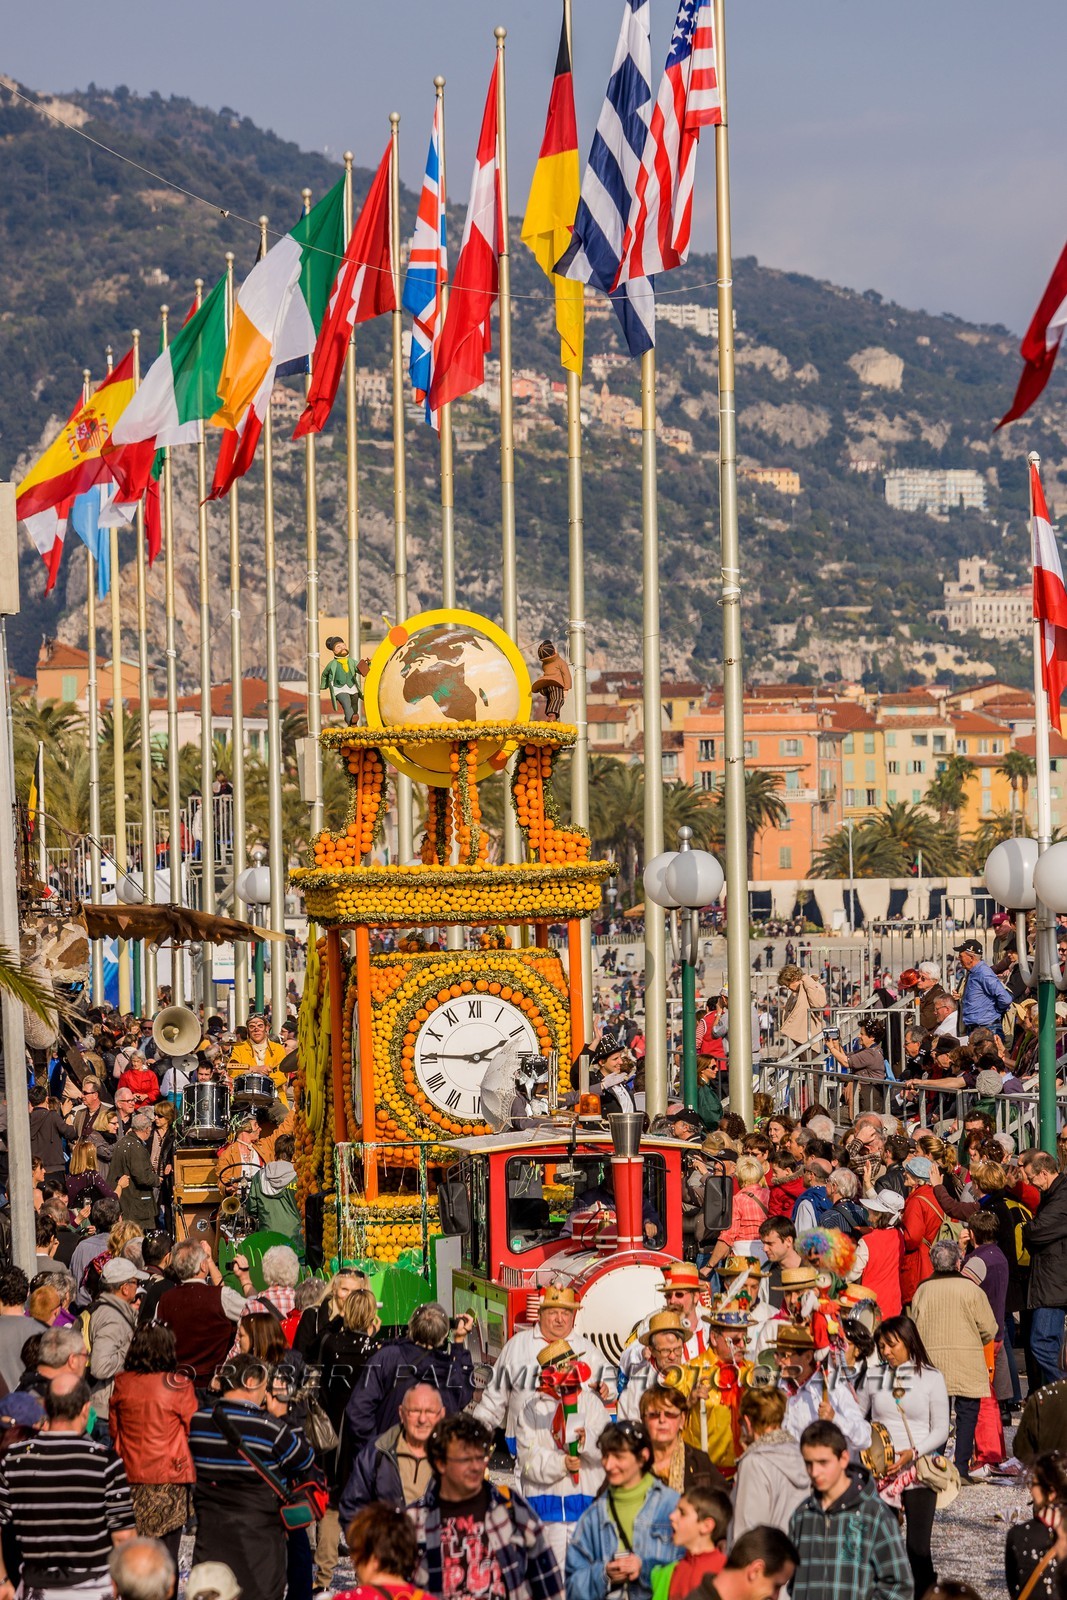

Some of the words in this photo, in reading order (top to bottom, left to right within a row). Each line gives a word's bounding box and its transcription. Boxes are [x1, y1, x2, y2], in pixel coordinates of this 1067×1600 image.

[442, 1007, 459, 1027] XI
[468, 1000, 482, 1018] XII
[425, 1028, 443, 1042] X
[509, 1025, 525, 1038] II
[425, 1072, 446, 1093] VIII
[445, 1089, 461, 1110] VII
